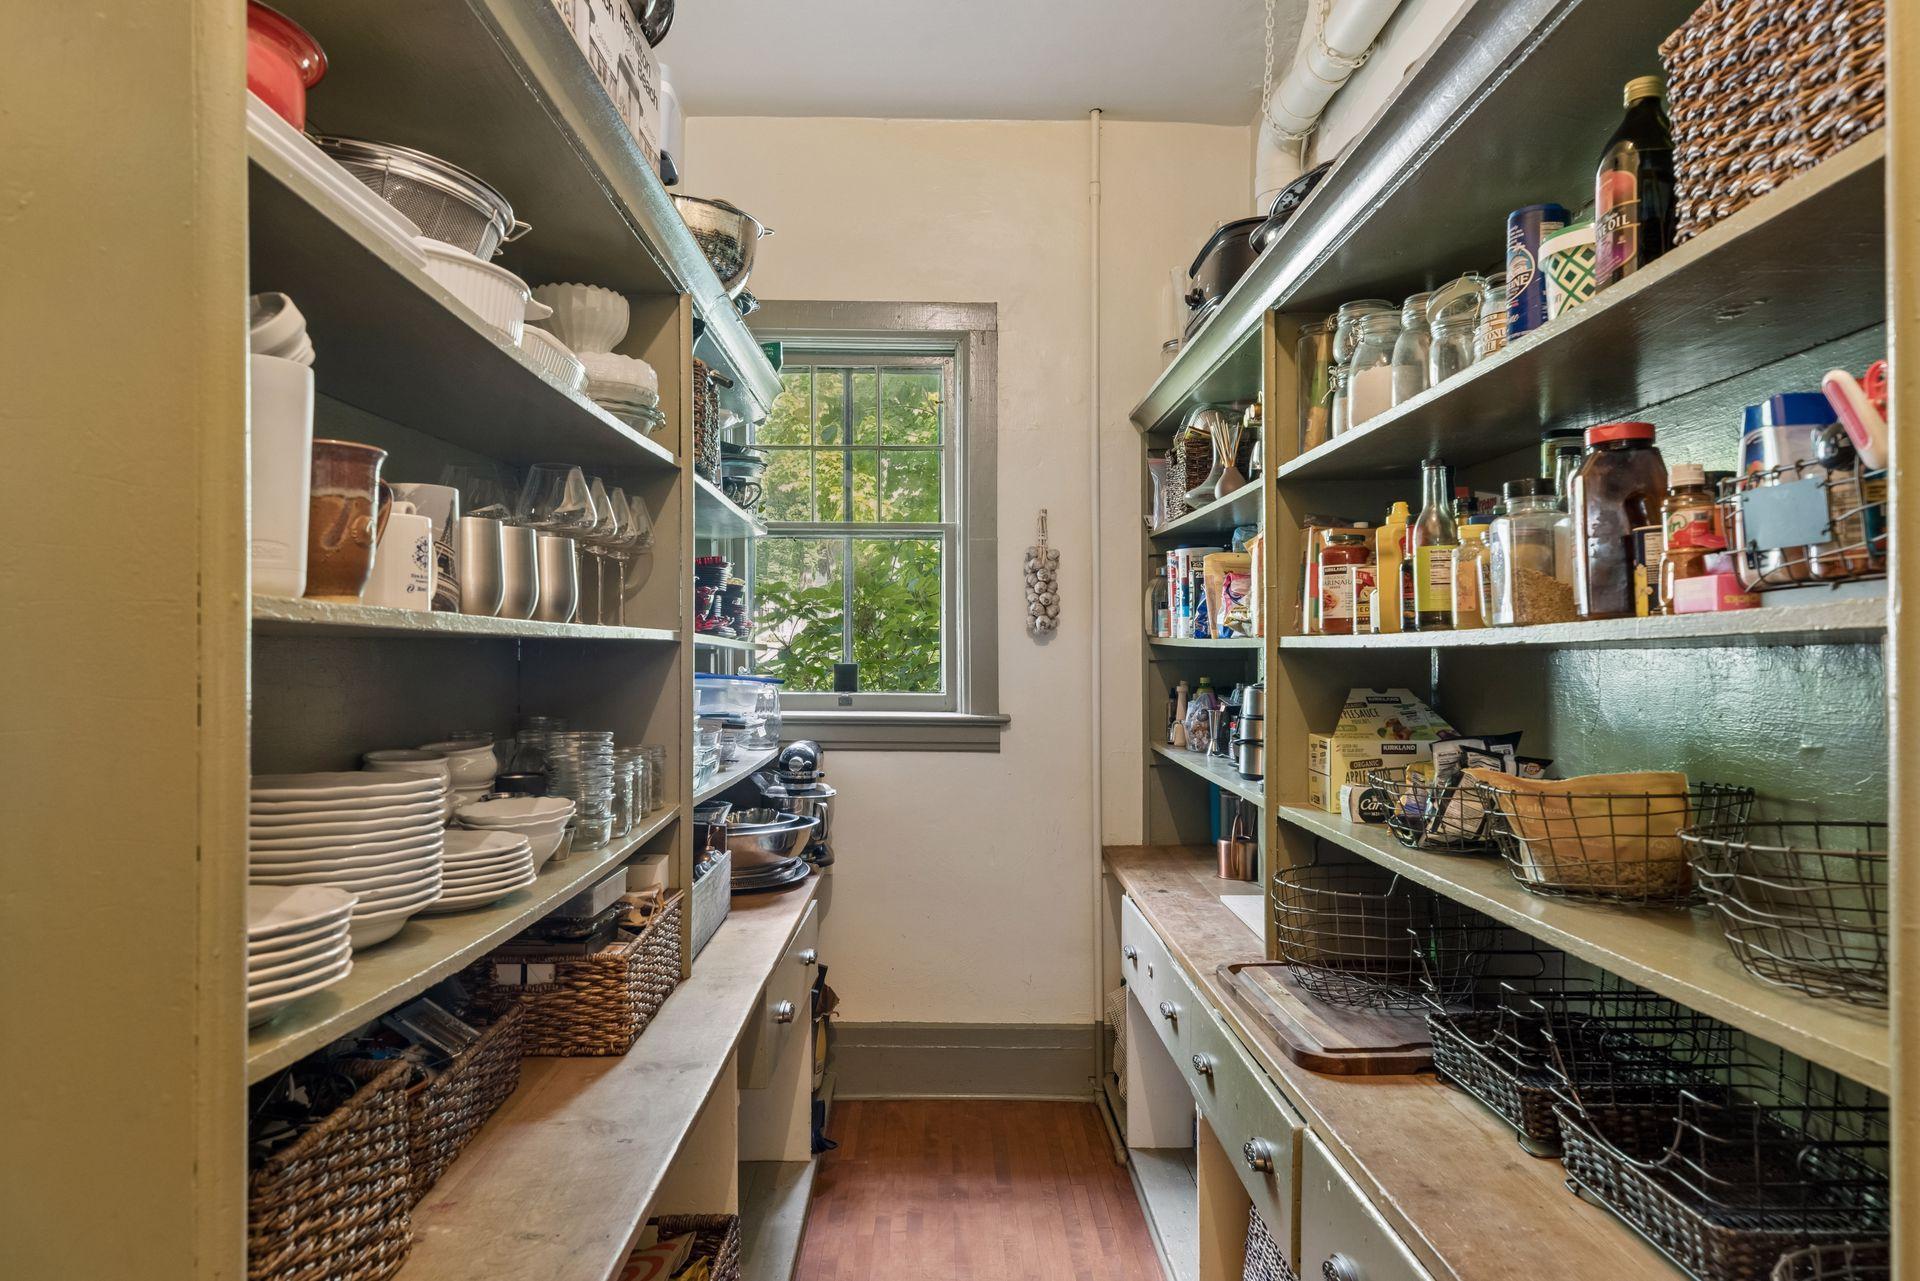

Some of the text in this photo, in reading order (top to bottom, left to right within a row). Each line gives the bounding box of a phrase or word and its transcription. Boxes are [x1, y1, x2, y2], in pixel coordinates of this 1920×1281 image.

[619, 4, 651, 76] Hamilton
[637, 59, 659, 112] Beach
[1353, 760, 1379, 768] ORGANIC
